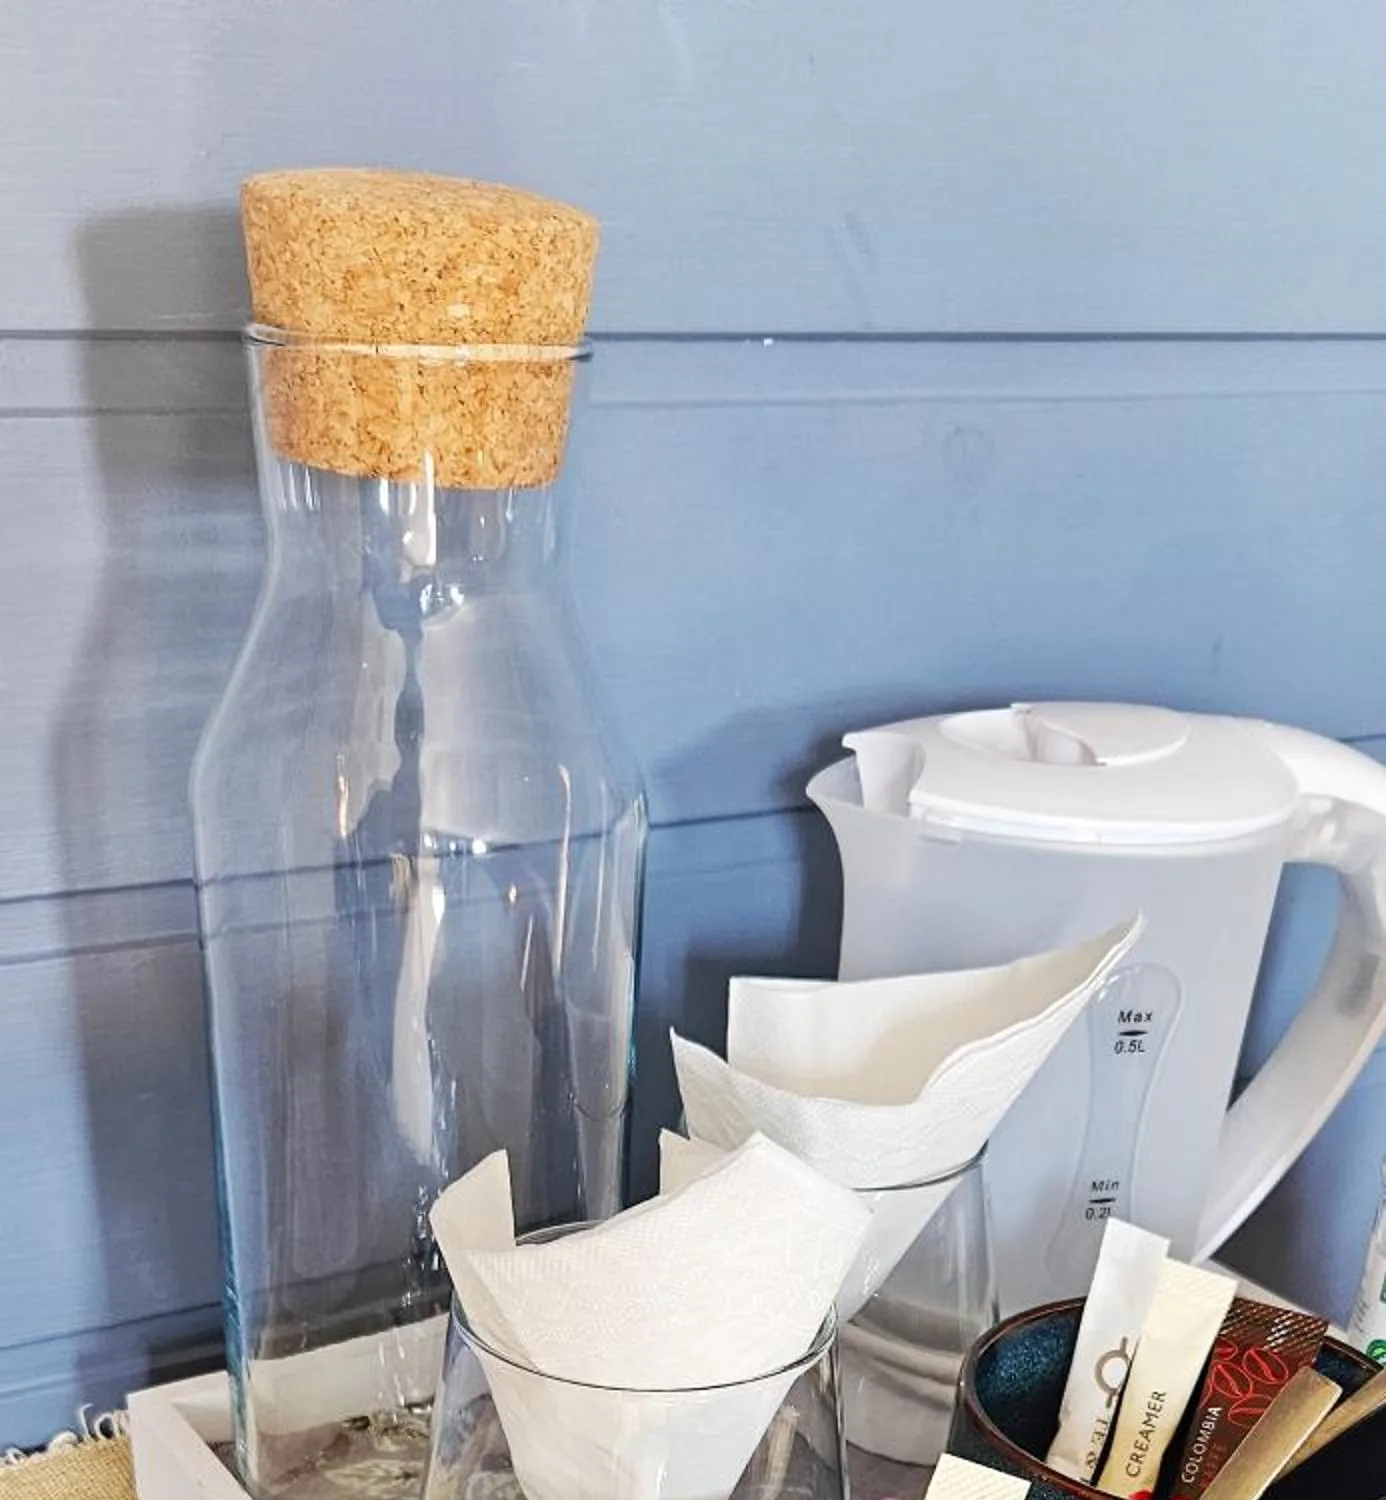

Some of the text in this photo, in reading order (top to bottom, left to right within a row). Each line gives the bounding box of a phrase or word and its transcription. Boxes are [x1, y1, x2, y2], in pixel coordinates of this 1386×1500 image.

[1117, 1010, 1153, 1023] Max
[1114, 1040, 1146, 1054] 0.5L
[1090, 1180, 1119, 1192] Min
[1126, 1390, 1167, 1478] CREAMER
[1181, 1405, 1223, 1484] COLOMBIA
